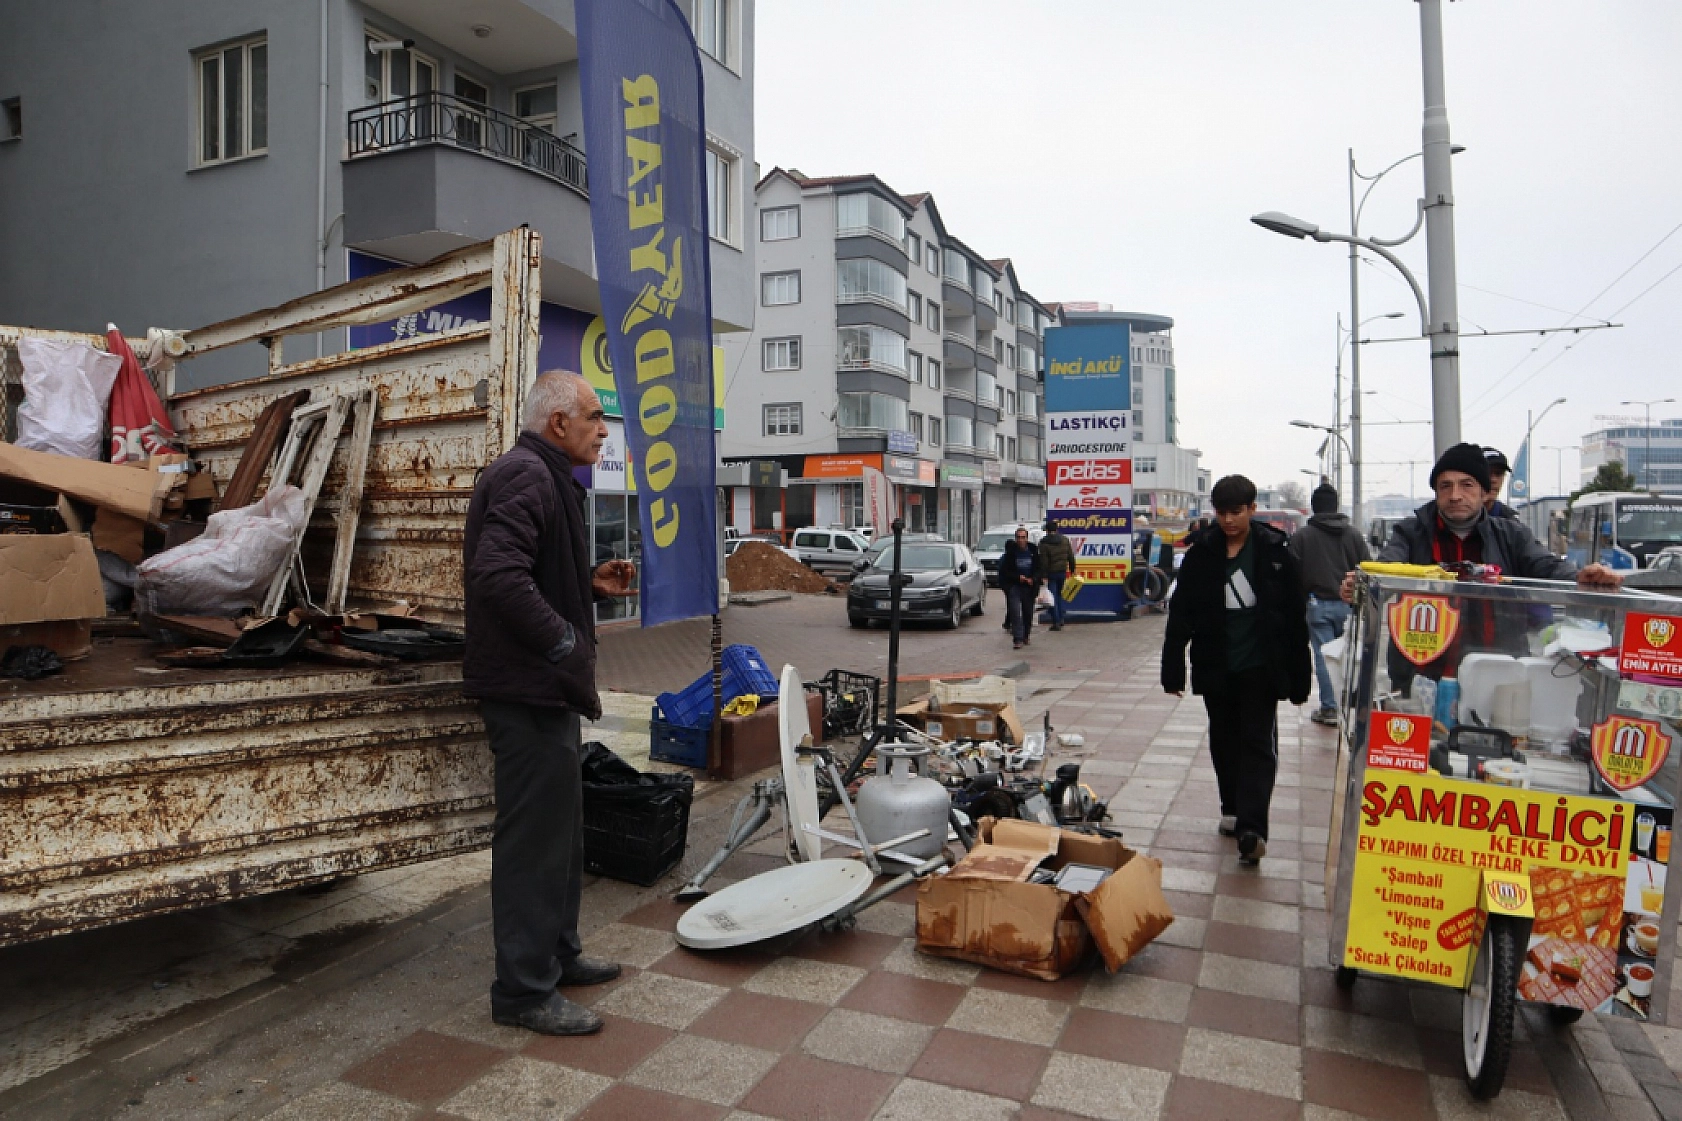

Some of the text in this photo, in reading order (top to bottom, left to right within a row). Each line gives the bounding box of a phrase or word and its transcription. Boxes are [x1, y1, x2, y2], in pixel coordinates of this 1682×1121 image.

[1049, 355, 1122, 375] İNCİ AKÜ
[1050, 413, 1127, 432] LASTİKÇİ
[1049, 442, 1127, 455] BRIDGESTONE
[1055, 460, 1121, 485] petlas
[1054, 497, 1123, 508] LASSA
[1070, 537, 1126, 557] VIKING
[1623, 658, 1650, 671] EMİN
[1369, 754, 1394, 766] EMİN
[1395, 757, 1425, 770] AYTEN
[1361, 781, 1625, 850] ŞAMBALİCİ
[1359, 835, 1522, 873] EV YAPIMI ÖZEL TATLAR
[1490, 834, 1619, 869] KEKE DAYI
[1387, 866, 1444, 889] Şambali
[1380, 887, 1445, 911] Limonata
[1393, 910, 1431, 931] Vişne
[1390, 931, 1428, 954] Salep
[1354, 947, 1452, 977] Sıcak Çikolata
